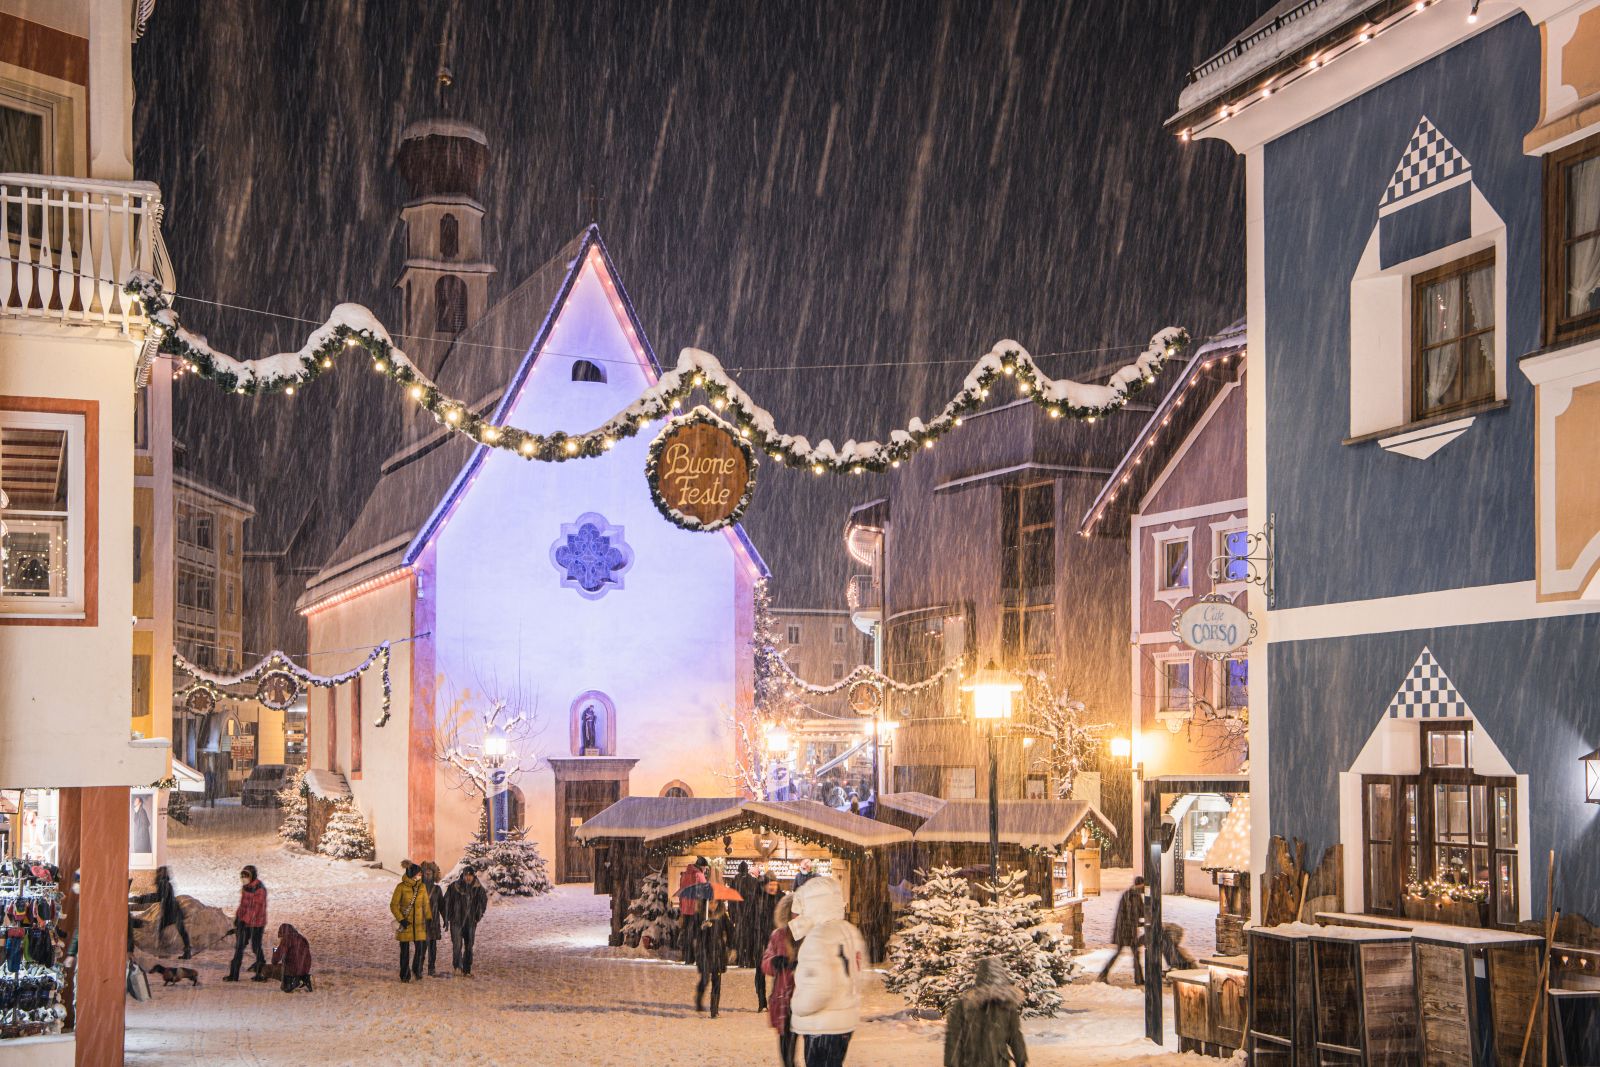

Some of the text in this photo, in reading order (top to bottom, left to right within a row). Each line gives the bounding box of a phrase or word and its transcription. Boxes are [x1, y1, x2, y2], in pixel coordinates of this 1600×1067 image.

[664, 443, 736, 479] Buone
[675, 474, 730, 506] Feste
[1191, 623, 1237, 646] CORSO
